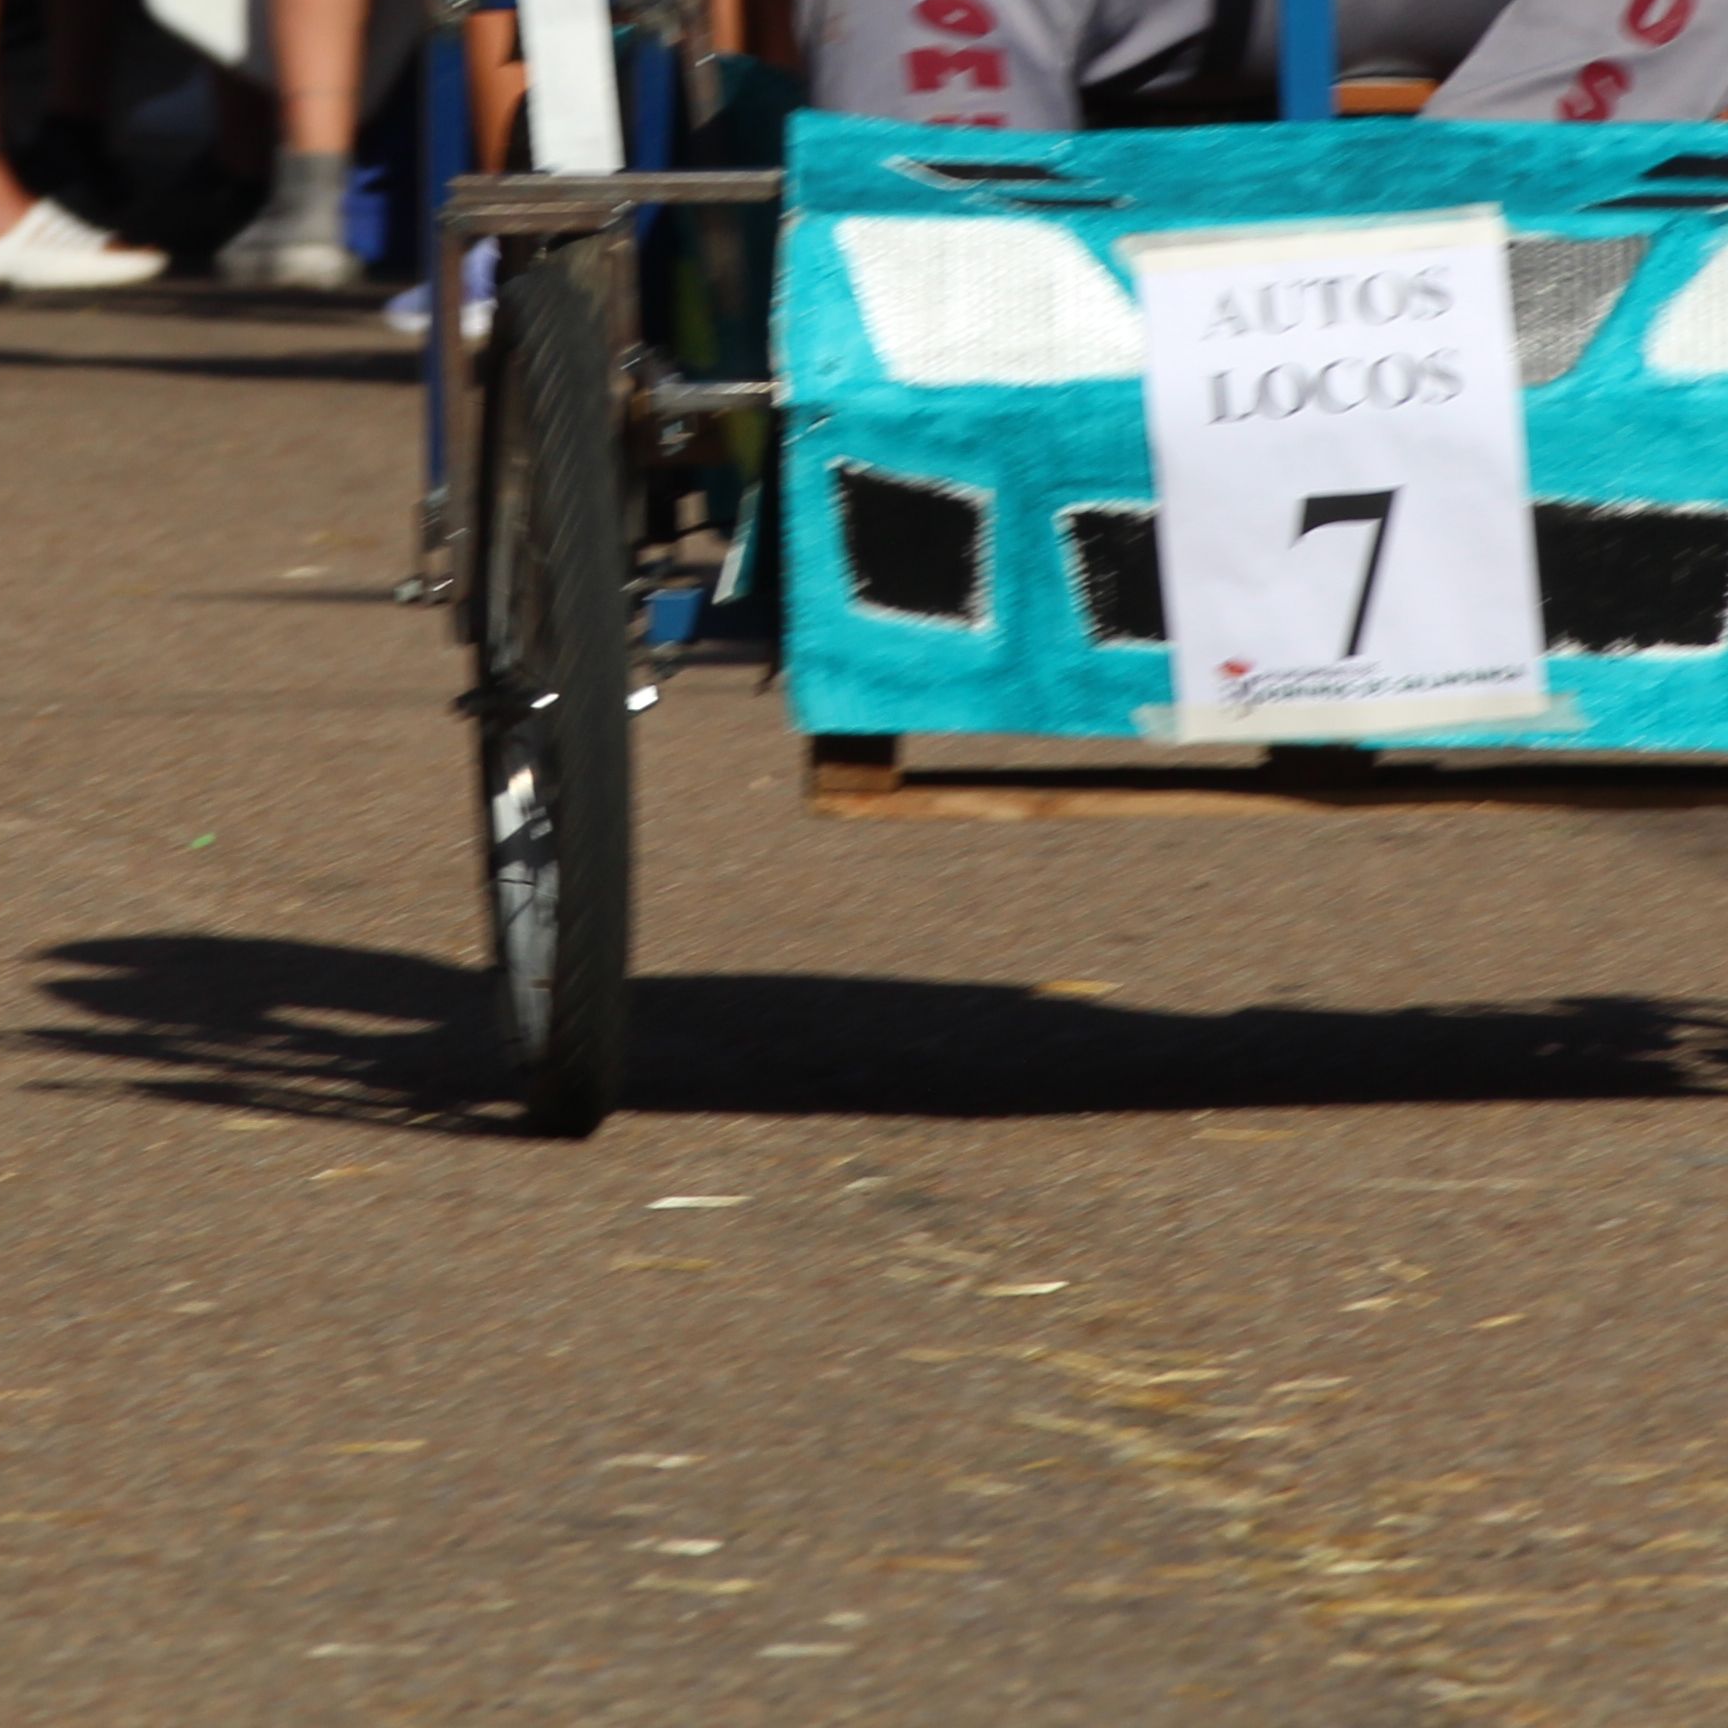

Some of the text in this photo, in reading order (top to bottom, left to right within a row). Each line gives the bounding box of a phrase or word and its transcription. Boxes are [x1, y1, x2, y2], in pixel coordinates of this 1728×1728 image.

[1198, 266, 1455, 341] AUTOS
[1204, 347, 1466, 425] LOCOS
[1289, 486, 1406, 659] 7
